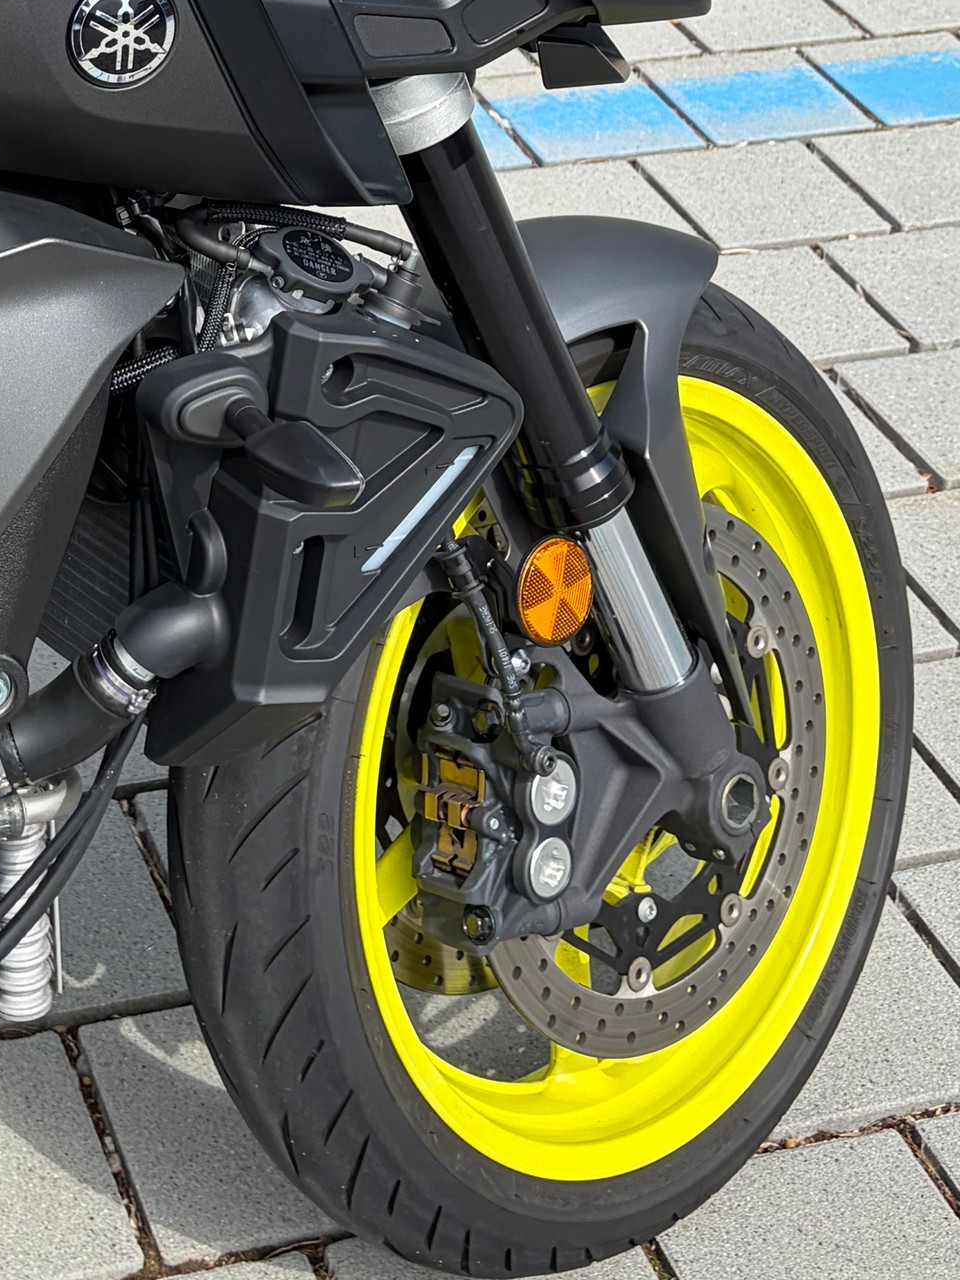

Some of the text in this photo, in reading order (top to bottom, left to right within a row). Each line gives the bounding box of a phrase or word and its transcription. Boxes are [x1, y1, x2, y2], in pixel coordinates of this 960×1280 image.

[302, 258, 337, 276] DANGER
[497, 647, 512, 669] J1401
[506, 673, 518, 690] SAE
